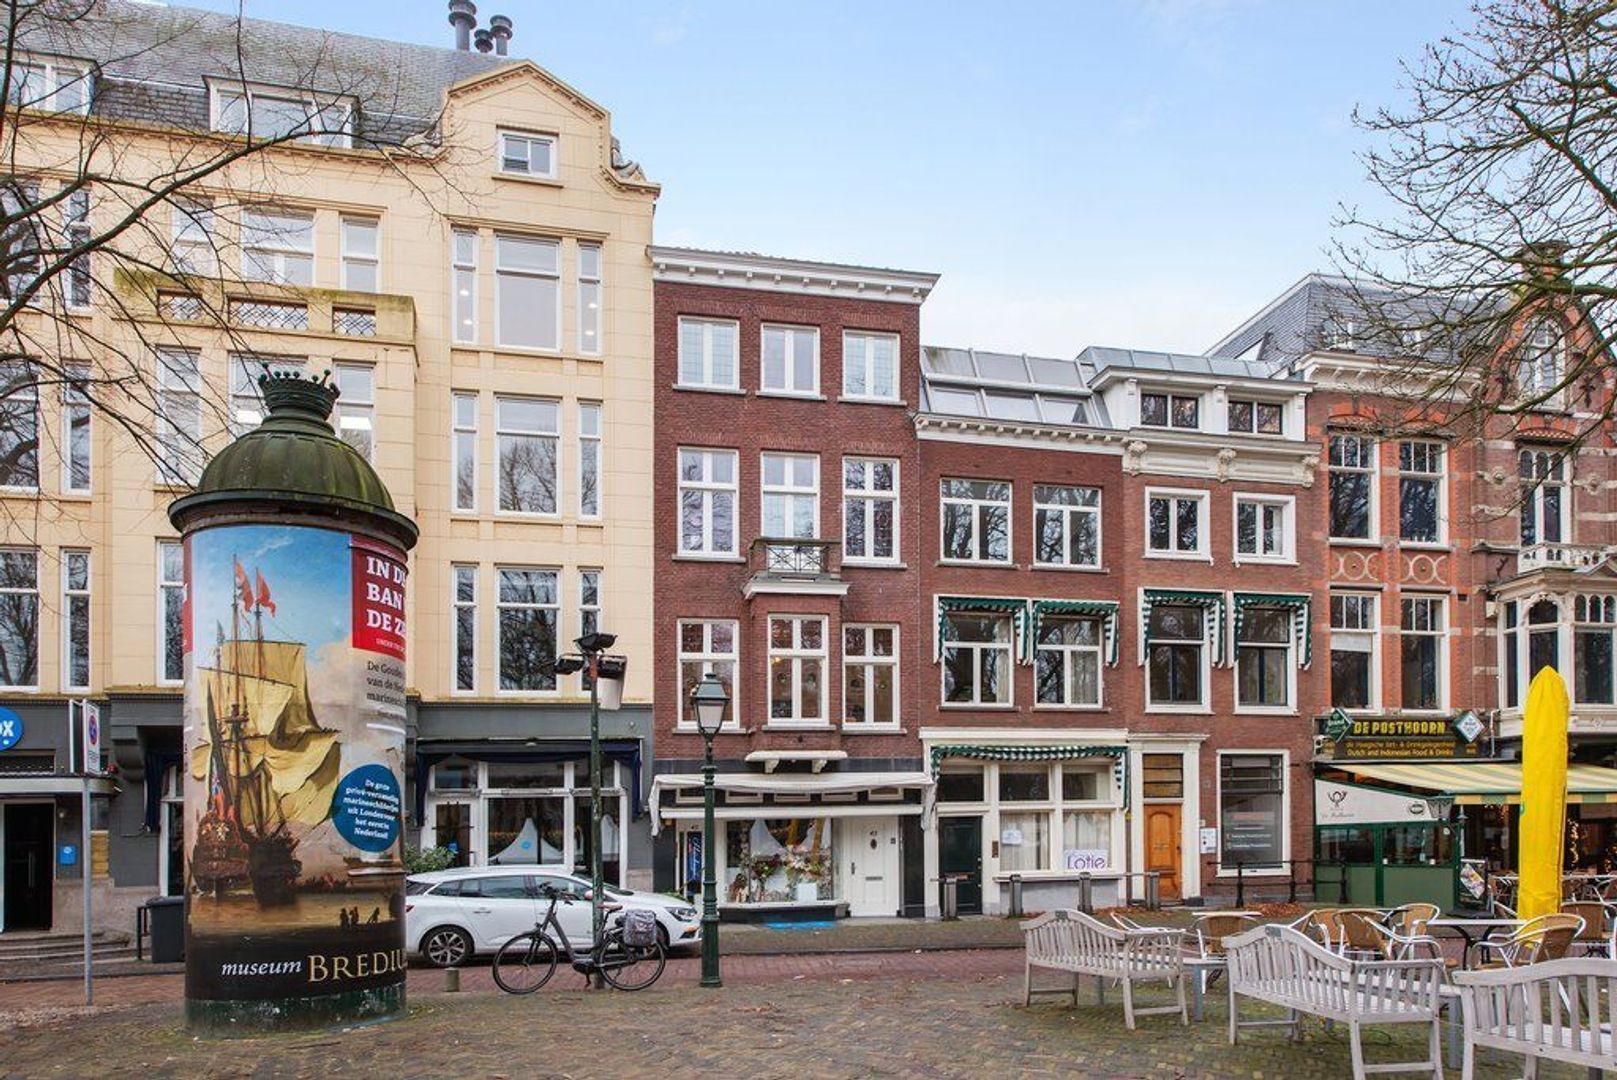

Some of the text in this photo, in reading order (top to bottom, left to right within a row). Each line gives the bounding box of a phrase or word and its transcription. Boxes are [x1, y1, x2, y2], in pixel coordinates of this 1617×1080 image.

[366, 556, 390, 579] IN
[366, 582, 402, 610] BAN
[366, 609, 392, 632] DE
[367, 661, 380, 672] De
[366, 677, 383, 687] van
[1353, 721, 1369, 735] DE
[1371, 721, 1446, 735] POSTHOORN
[221, 959, 302, 976] museum
